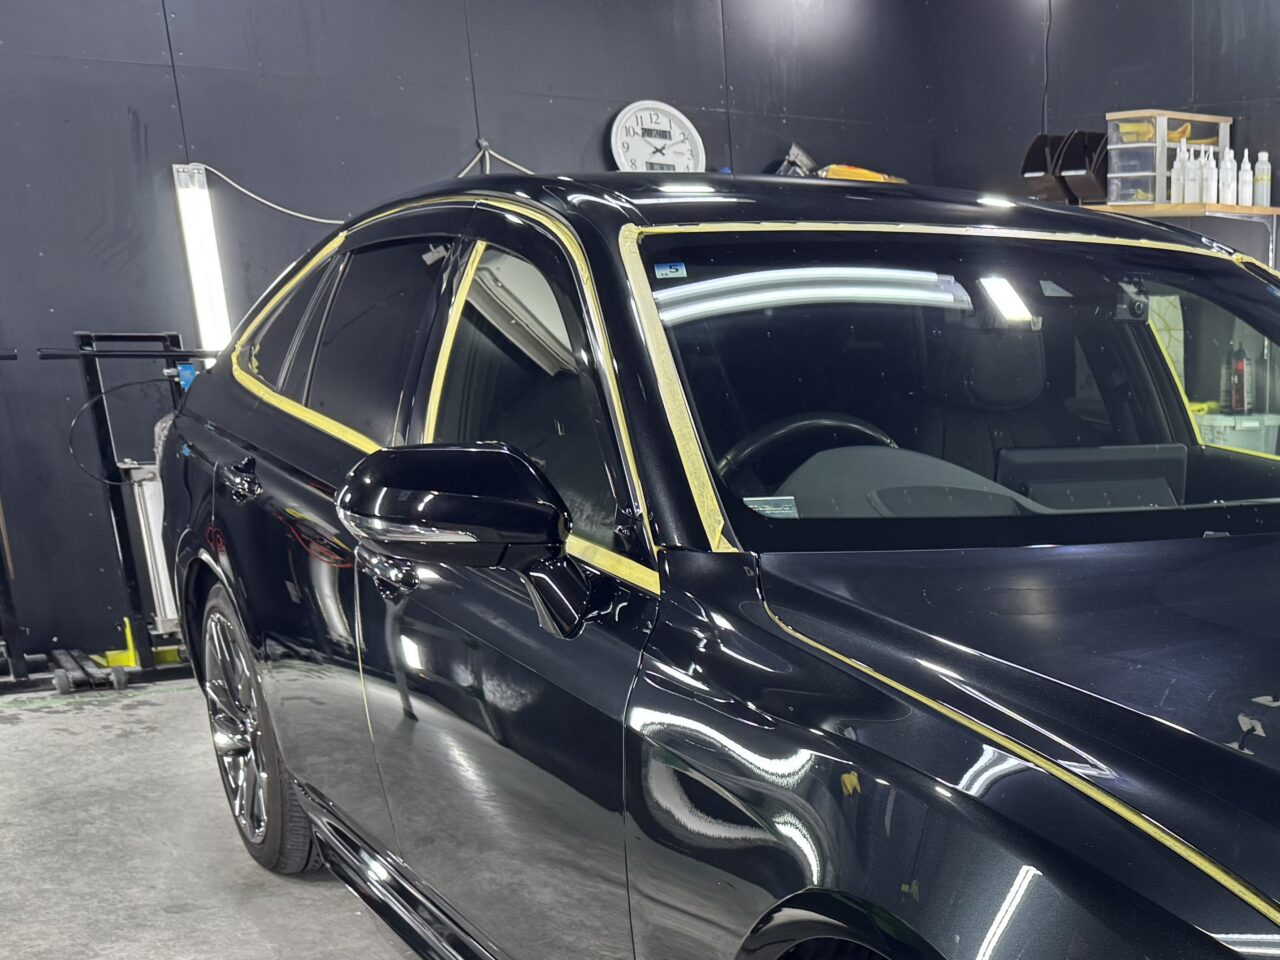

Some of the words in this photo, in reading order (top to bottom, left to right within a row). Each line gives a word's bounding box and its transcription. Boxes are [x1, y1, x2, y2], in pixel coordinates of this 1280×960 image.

[649, 112, 661, 125] 12
[624, 125, 636, 137] 10
[622, 142, 630, 153] 9
[630, 159, 638, 170] 8
[668, 264, 680, 274] 5
